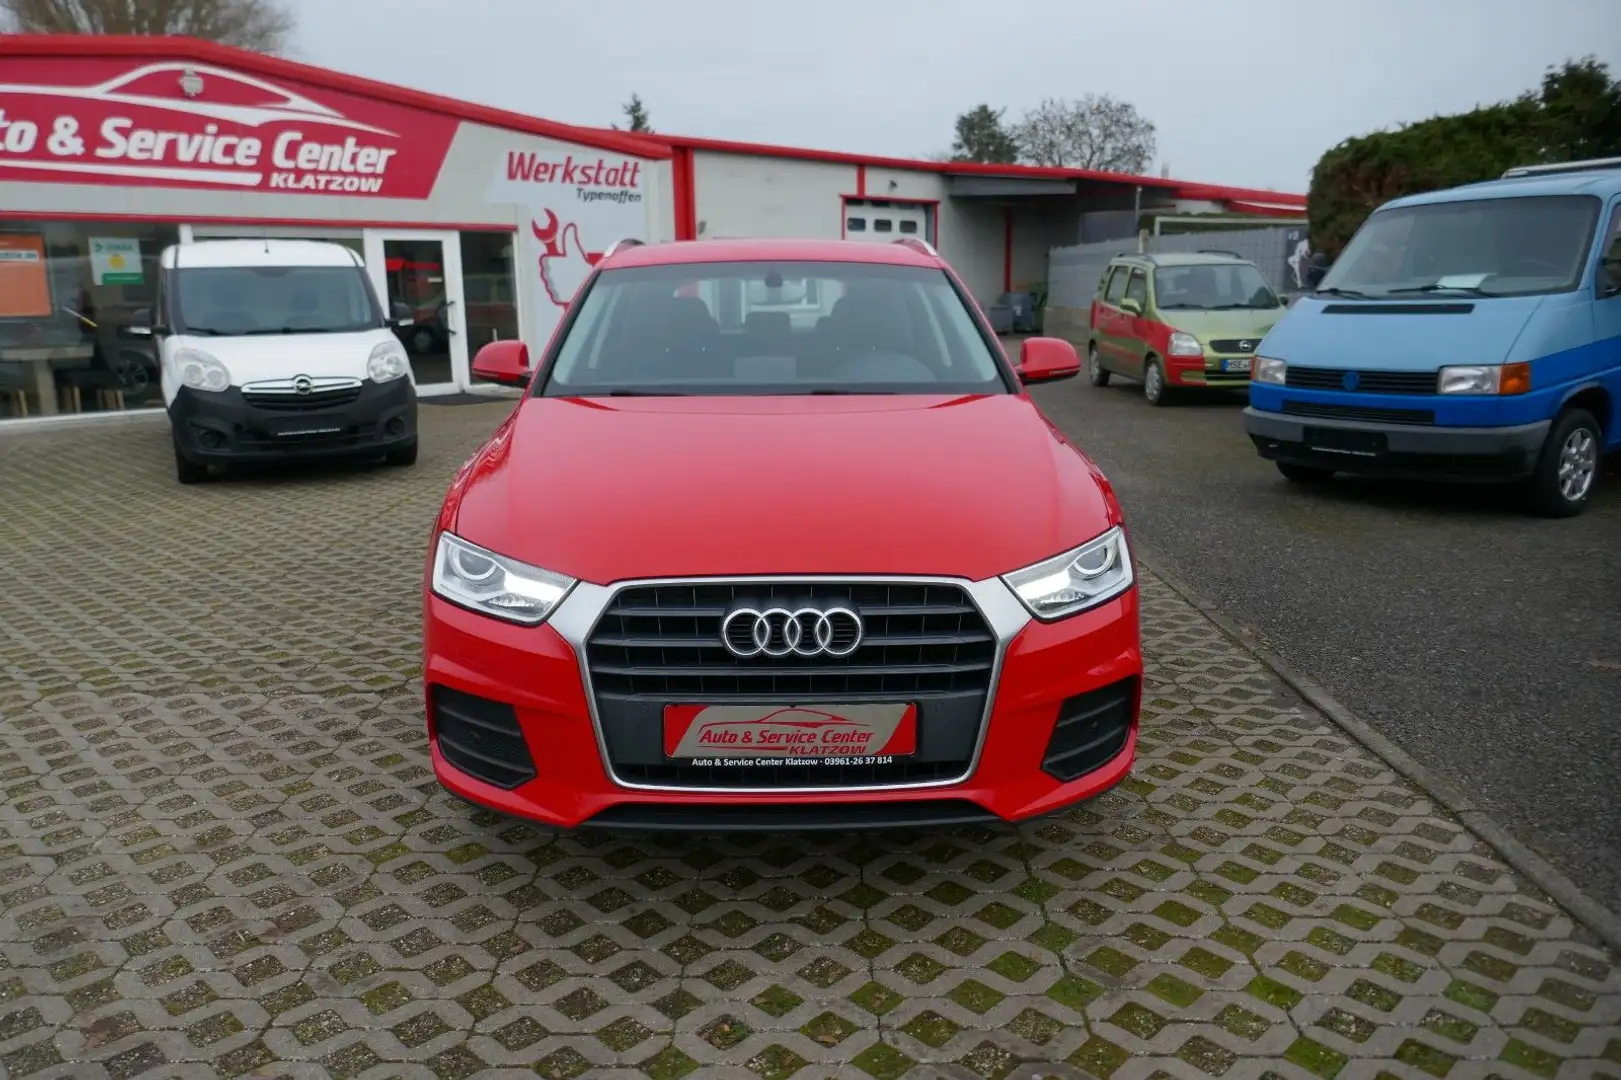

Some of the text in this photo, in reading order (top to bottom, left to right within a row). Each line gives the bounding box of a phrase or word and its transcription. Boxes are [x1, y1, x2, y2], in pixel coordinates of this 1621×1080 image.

[47, 115, 85, 156] &
[95, 116, 262, 166] Service
[272, 130, 397, 174] Center
[507, 151, 641, 188] Werkstatt
[269, 172, 383, 192] KLATZOW
[576, 187, 641, 204] Typenoffen
[700, 729, 874, 743] Auto & Service Center
[789, 745, 867, 755] KLATZOW
[692, 756, 893, 766] Auto & Service Center Klatzow 03961-26 37 814
